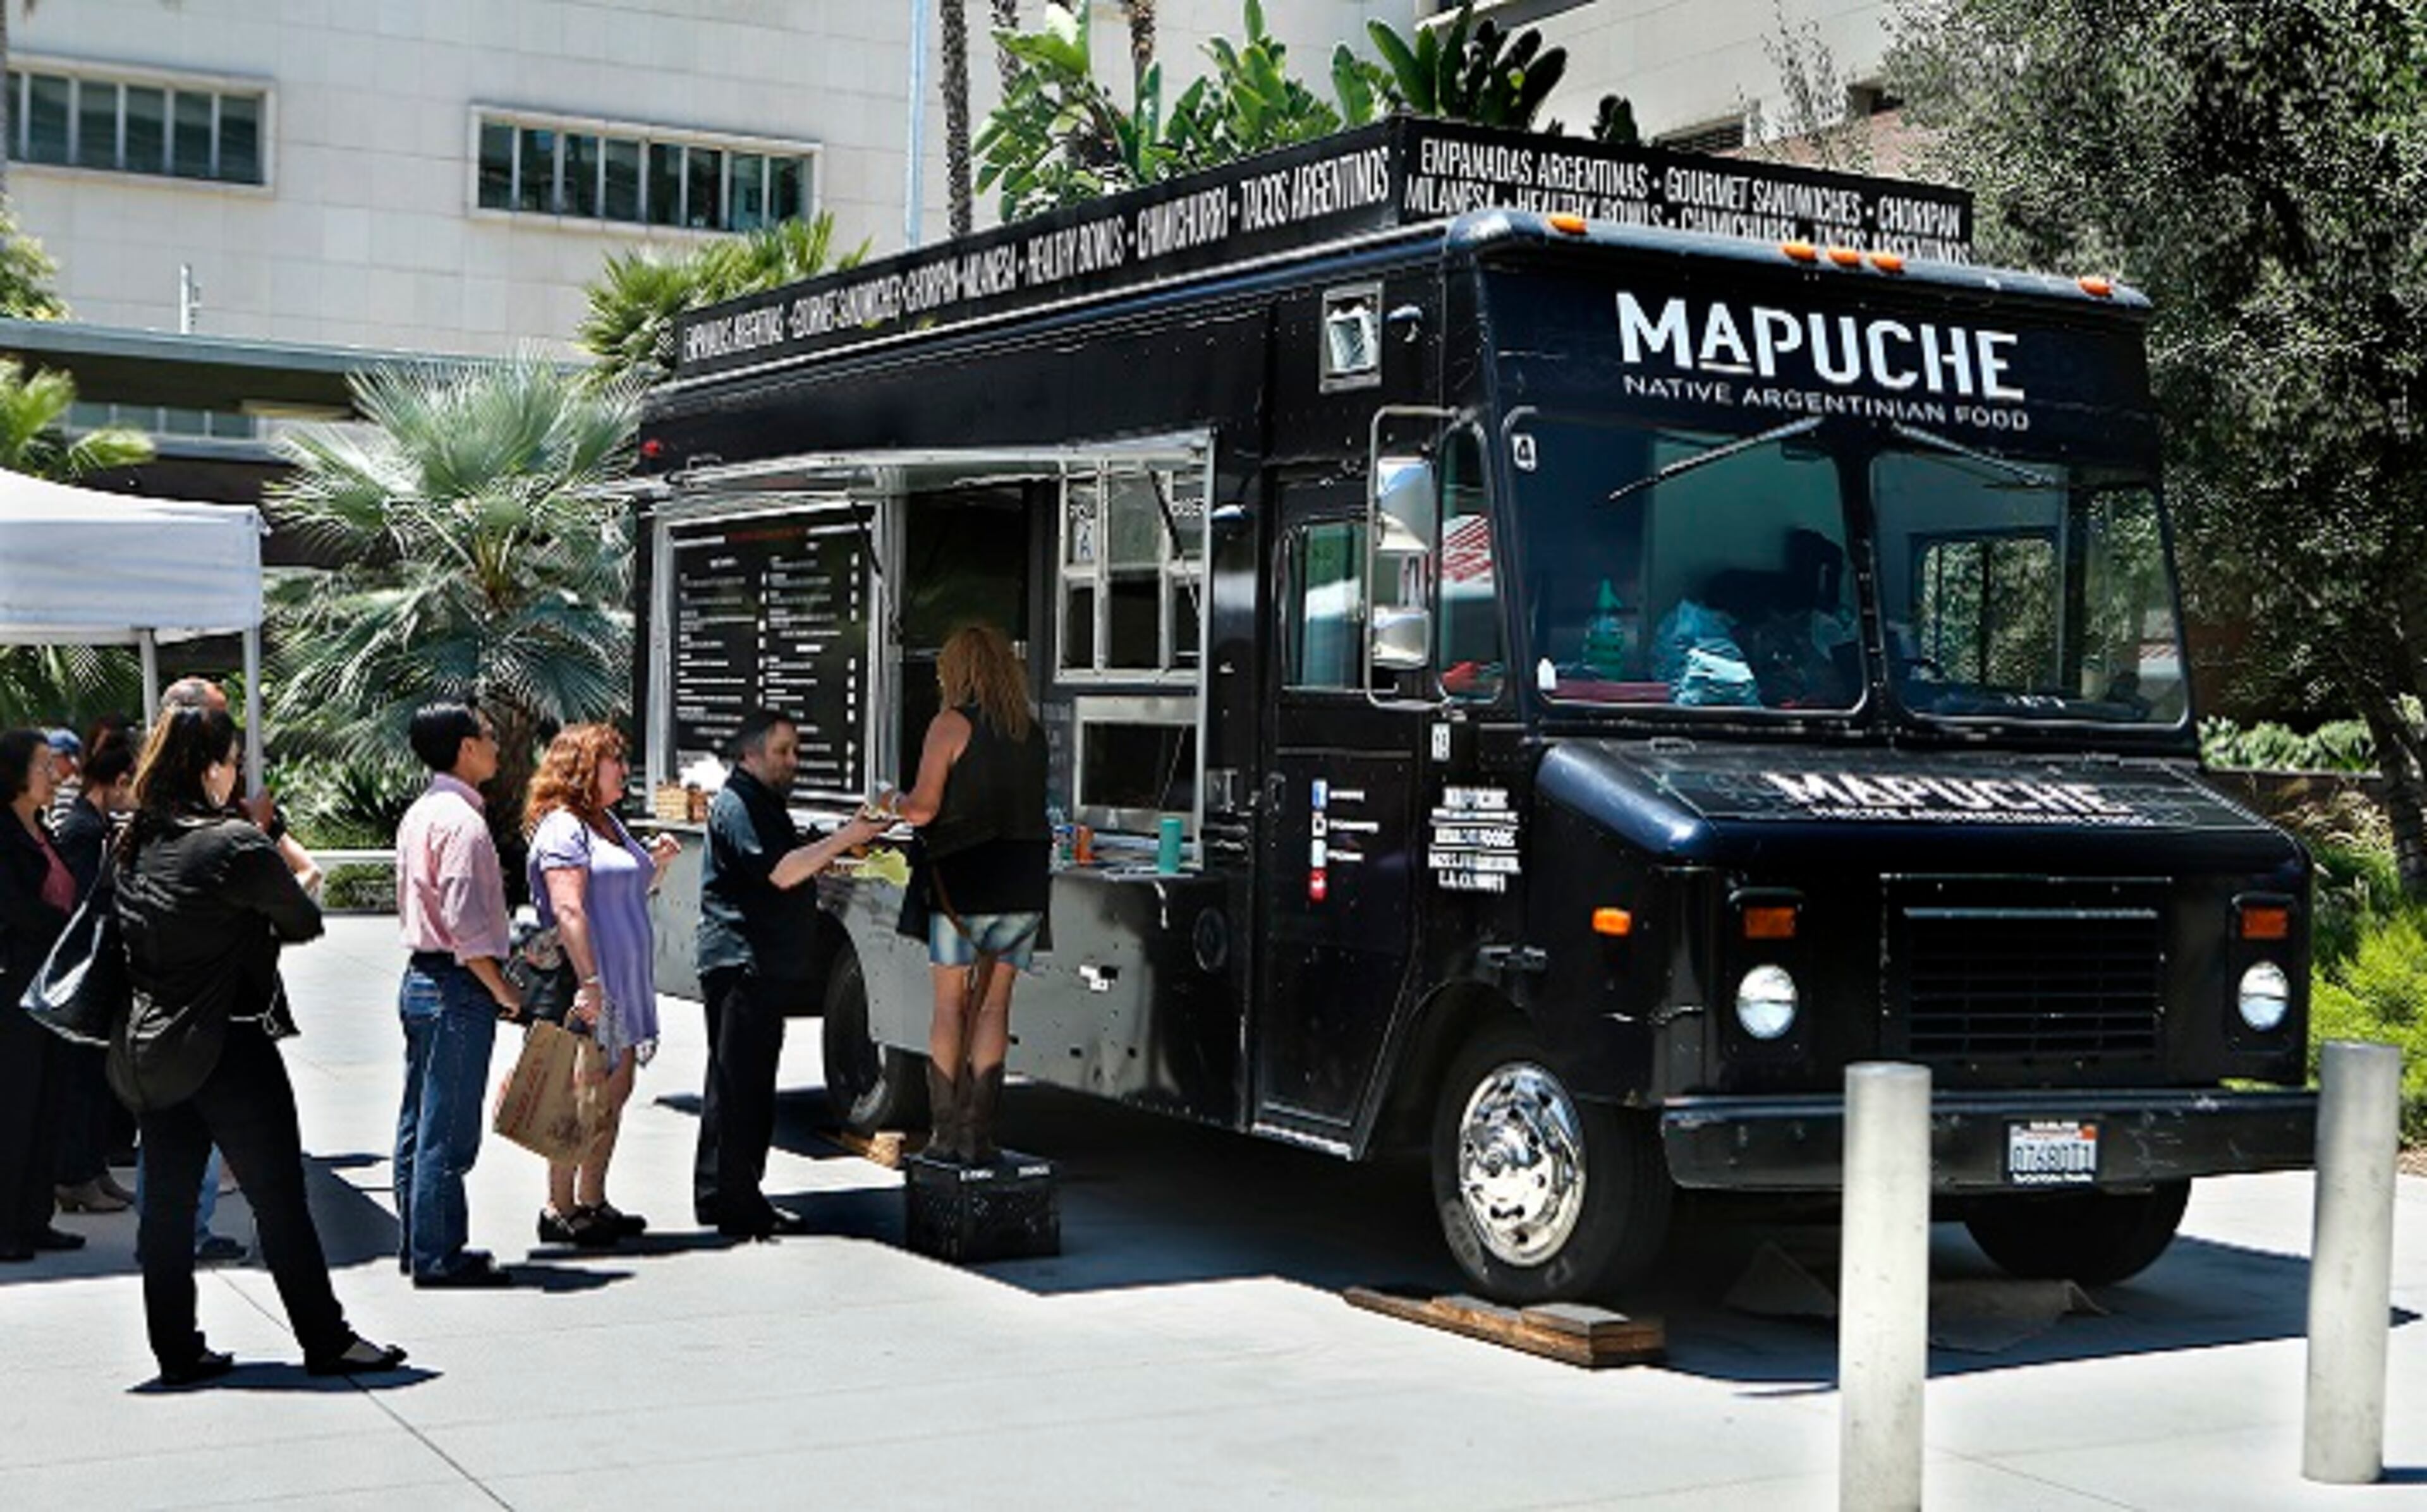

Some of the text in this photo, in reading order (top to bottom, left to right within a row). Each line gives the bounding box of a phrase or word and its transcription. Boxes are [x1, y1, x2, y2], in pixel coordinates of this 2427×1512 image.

[1240, 169, 1289, 232] TACOS
[1290, 145, 1390, 221] ARGENTINOS
[1404, 173, 1496, 214] MILANESA
[1420, 137, 1960, 238] EMPANADAS ARGENTINAS GOURMET SANDWICHES CHORIPAN
[1615, 291, 2025, 401] MAPUCHE
[1624, 374, 2031, 432] NATIVE ARGENTINIAN FOOD
[1760, 771, 2134, 813] MAPUCHE
